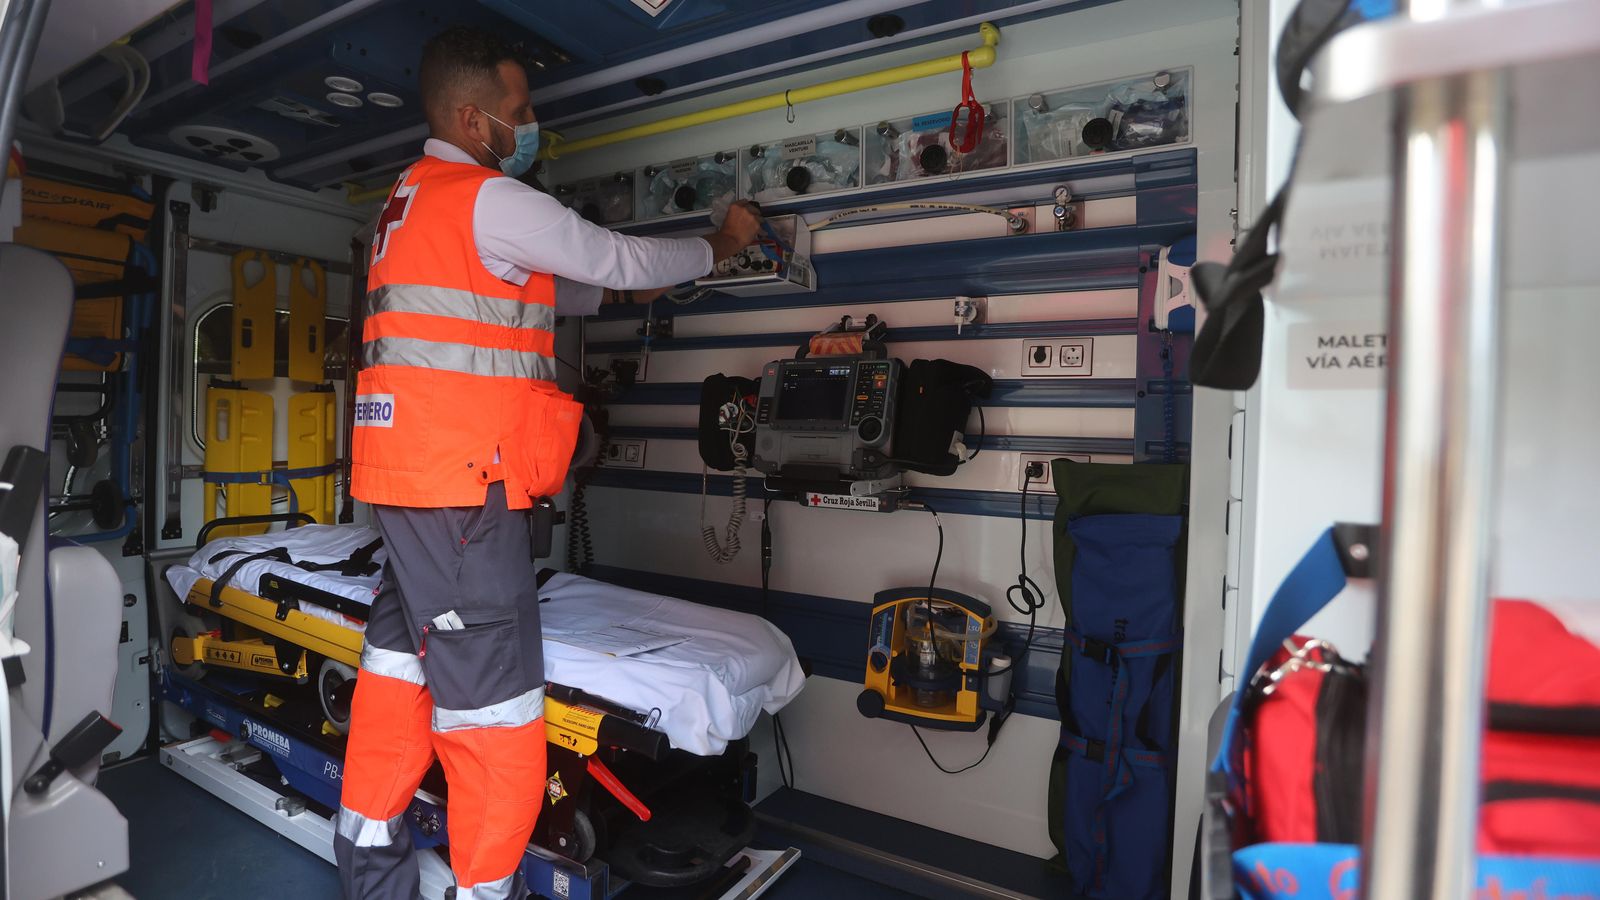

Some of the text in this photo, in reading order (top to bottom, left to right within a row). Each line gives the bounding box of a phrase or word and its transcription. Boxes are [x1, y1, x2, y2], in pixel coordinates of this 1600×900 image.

[61, 195, 112, 210] CHAIR
[1306, 352, 1341, 369] VÍA
[823, 495, 877, 508] Cruz Roja Sevilla
[252, 722, 290, 751] PROMEBA
[323, 760, 344, 780] PB-
